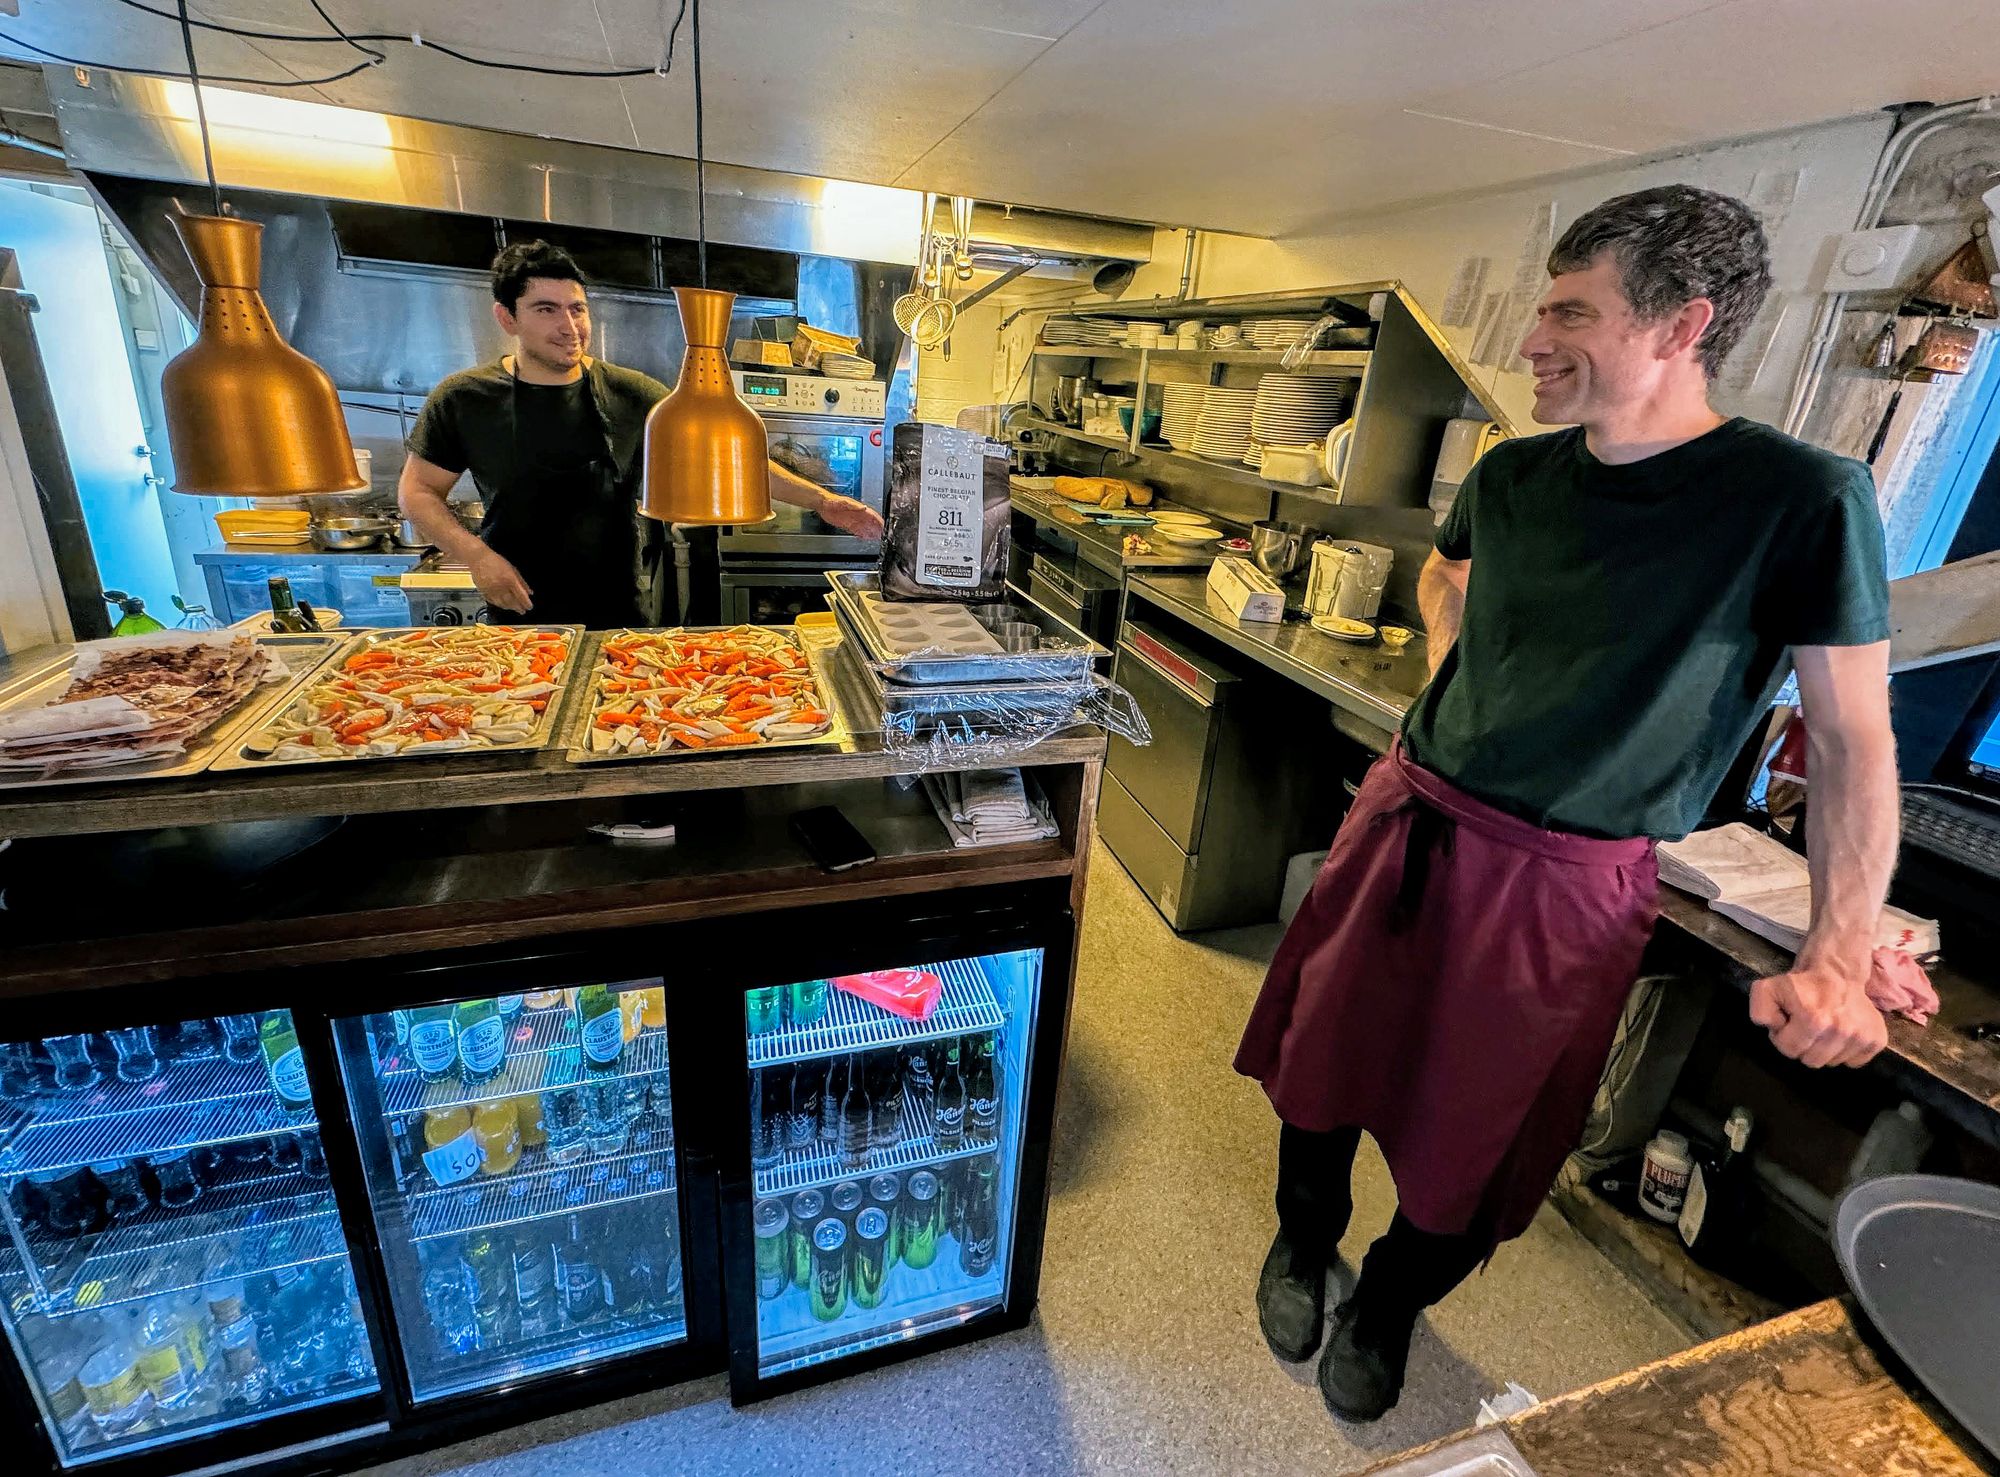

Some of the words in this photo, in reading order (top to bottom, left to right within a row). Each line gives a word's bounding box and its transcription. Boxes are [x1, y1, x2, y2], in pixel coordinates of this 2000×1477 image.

[927, 468, 976, 481] CALLEBAUT
[927, 486, 948, 494] FINEST
[950, 488, 976, 496] BELGIAN
[938, 510, 964, 527] 811
[750, 998, 780, 1010] LITE
